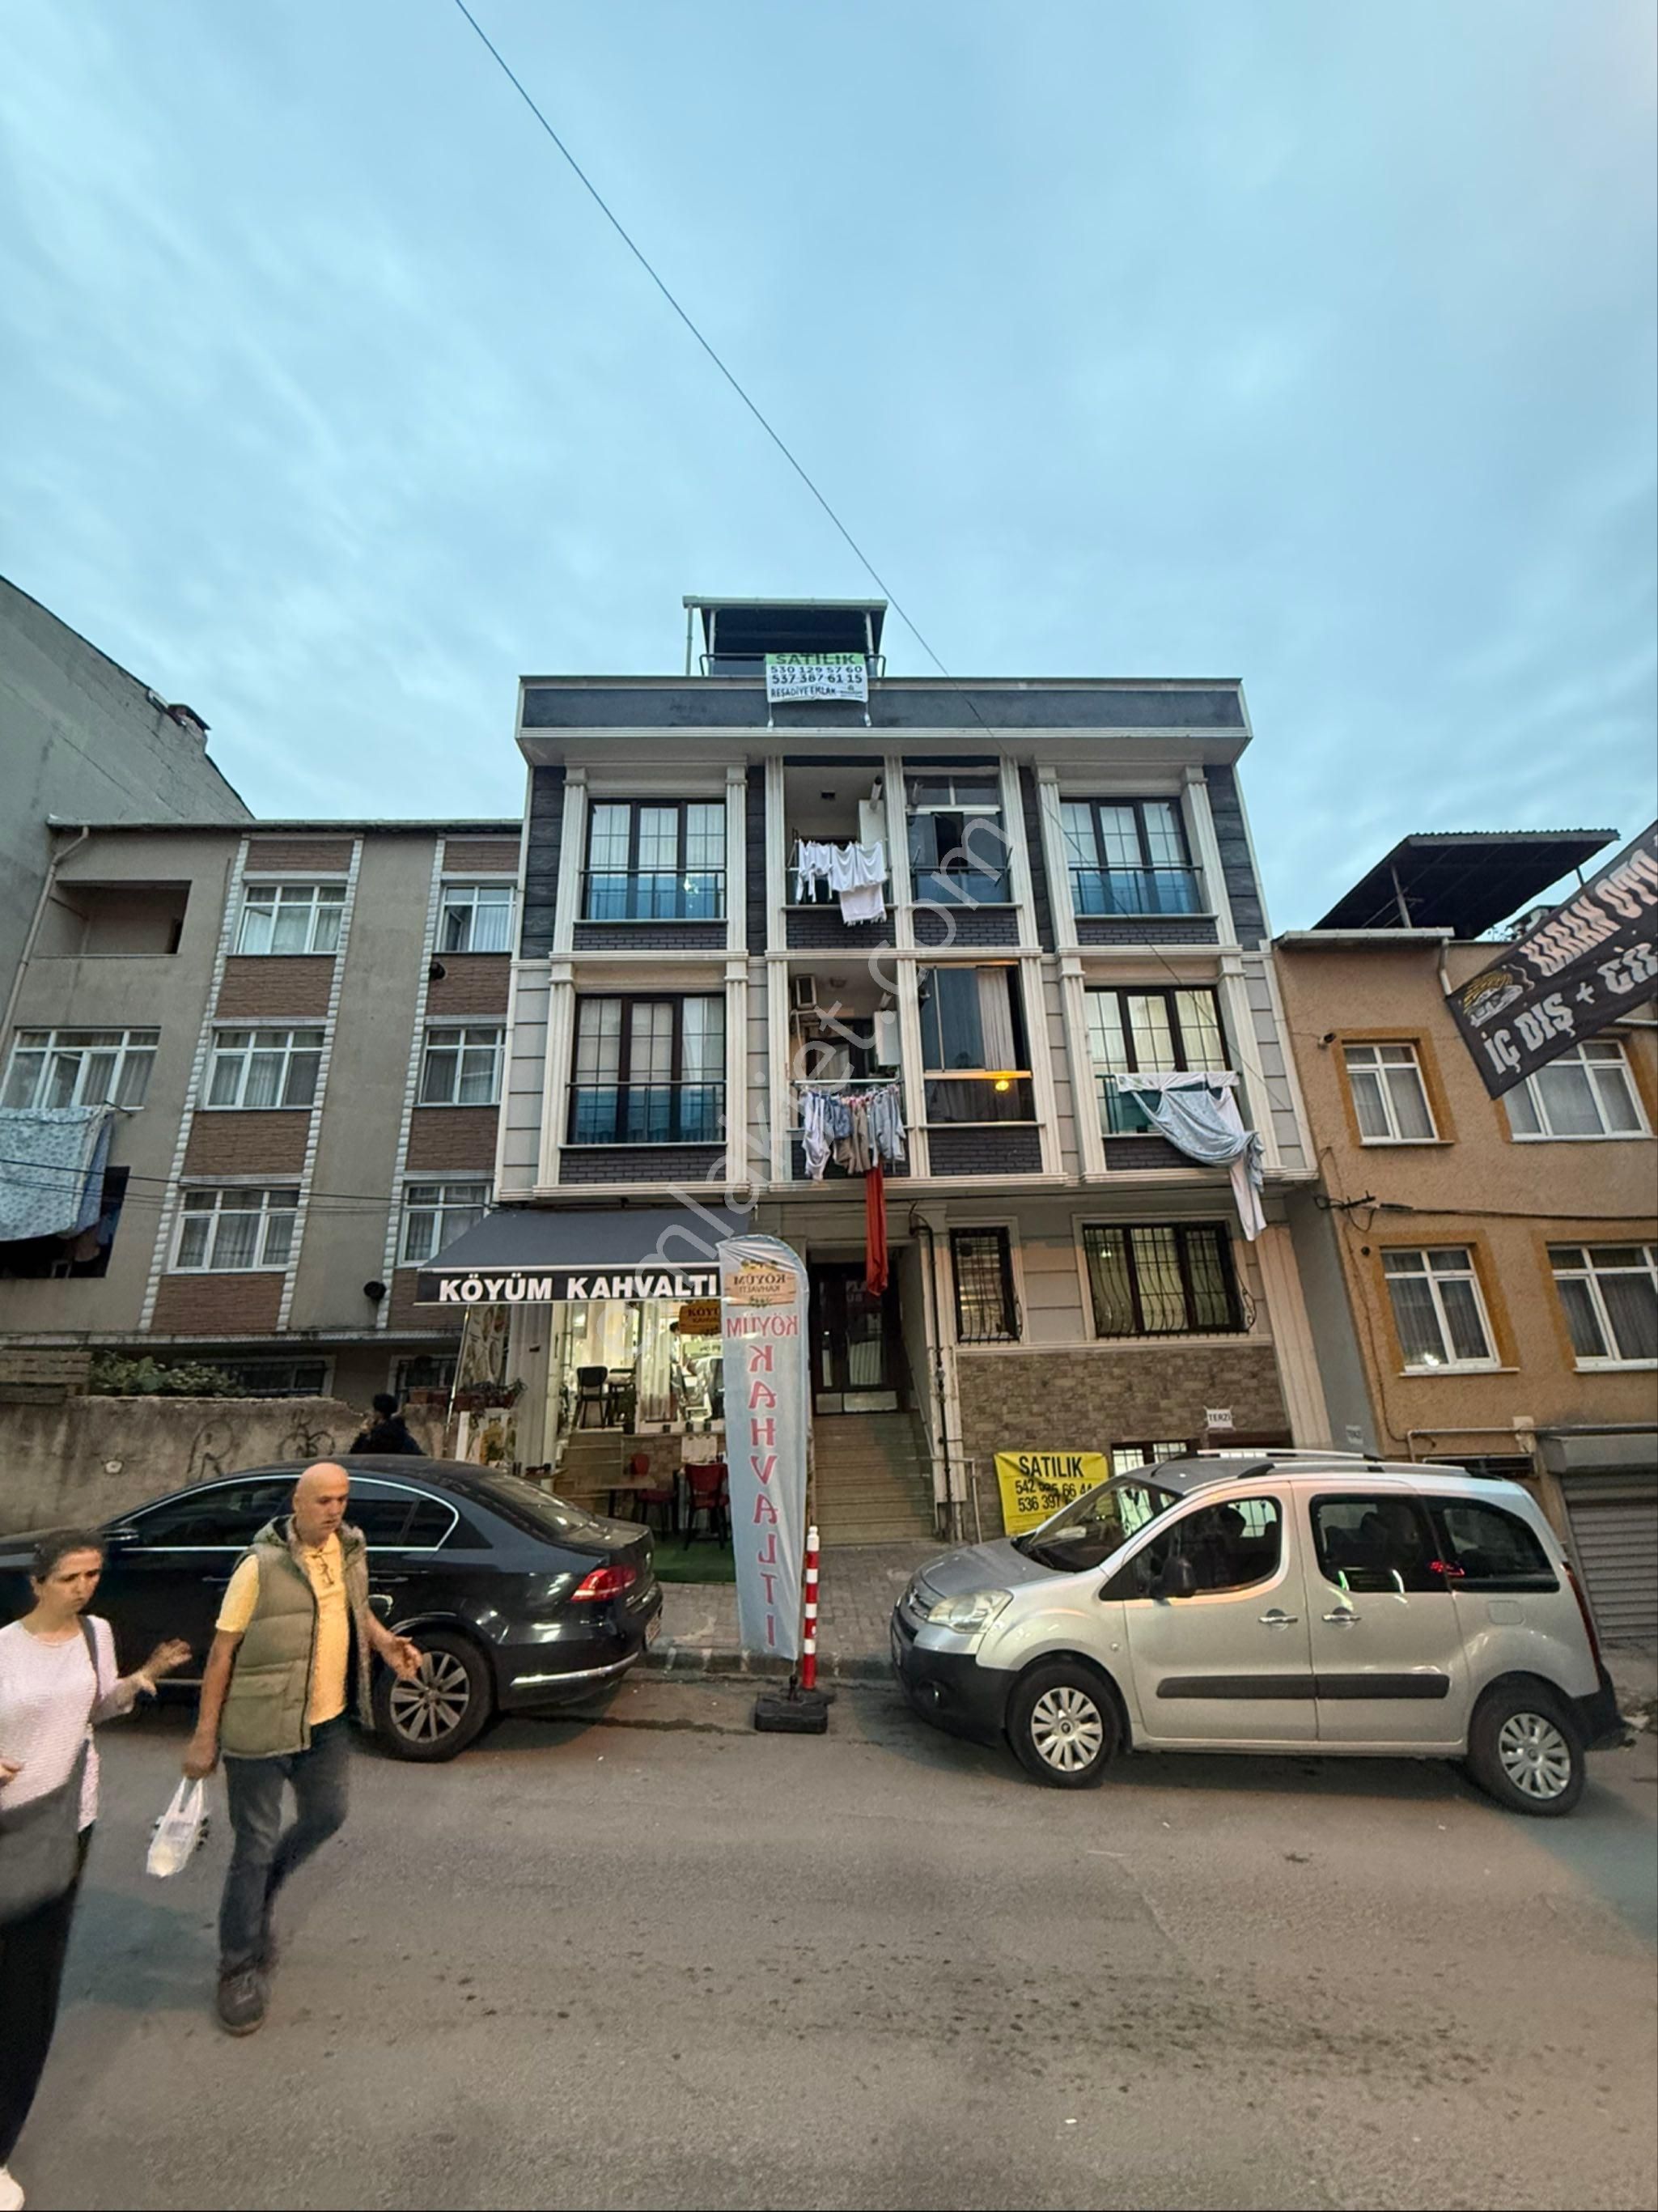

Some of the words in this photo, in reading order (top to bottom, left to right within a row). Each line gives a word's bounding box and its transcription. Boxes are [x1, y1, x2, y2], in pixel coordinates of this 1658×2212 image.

[775, 654, 856, 664] SATILIK
[770, 665, 795, 673] 530
[846, 665, 863, 673] 60
[772, 673, 795, 684] 537
[827, 673, 842, 683] 61
[846, 673, 863, 683] 15
[1480, 1029, 1521, 1075] İÇ
[1513, 992, 1576, 1051] DIŞ
[439, 1272, 553, 1301] KÖYÜM
[566, 1274, 718, 1300] KAHVALTI
[1018, 1455, 1084, 1478] SATILIK
[1015, 1479, 1037, 1495] 542
[1062, 1483, 1077, 1497] 66
[1018, 1496, 1039, 1513] 536
